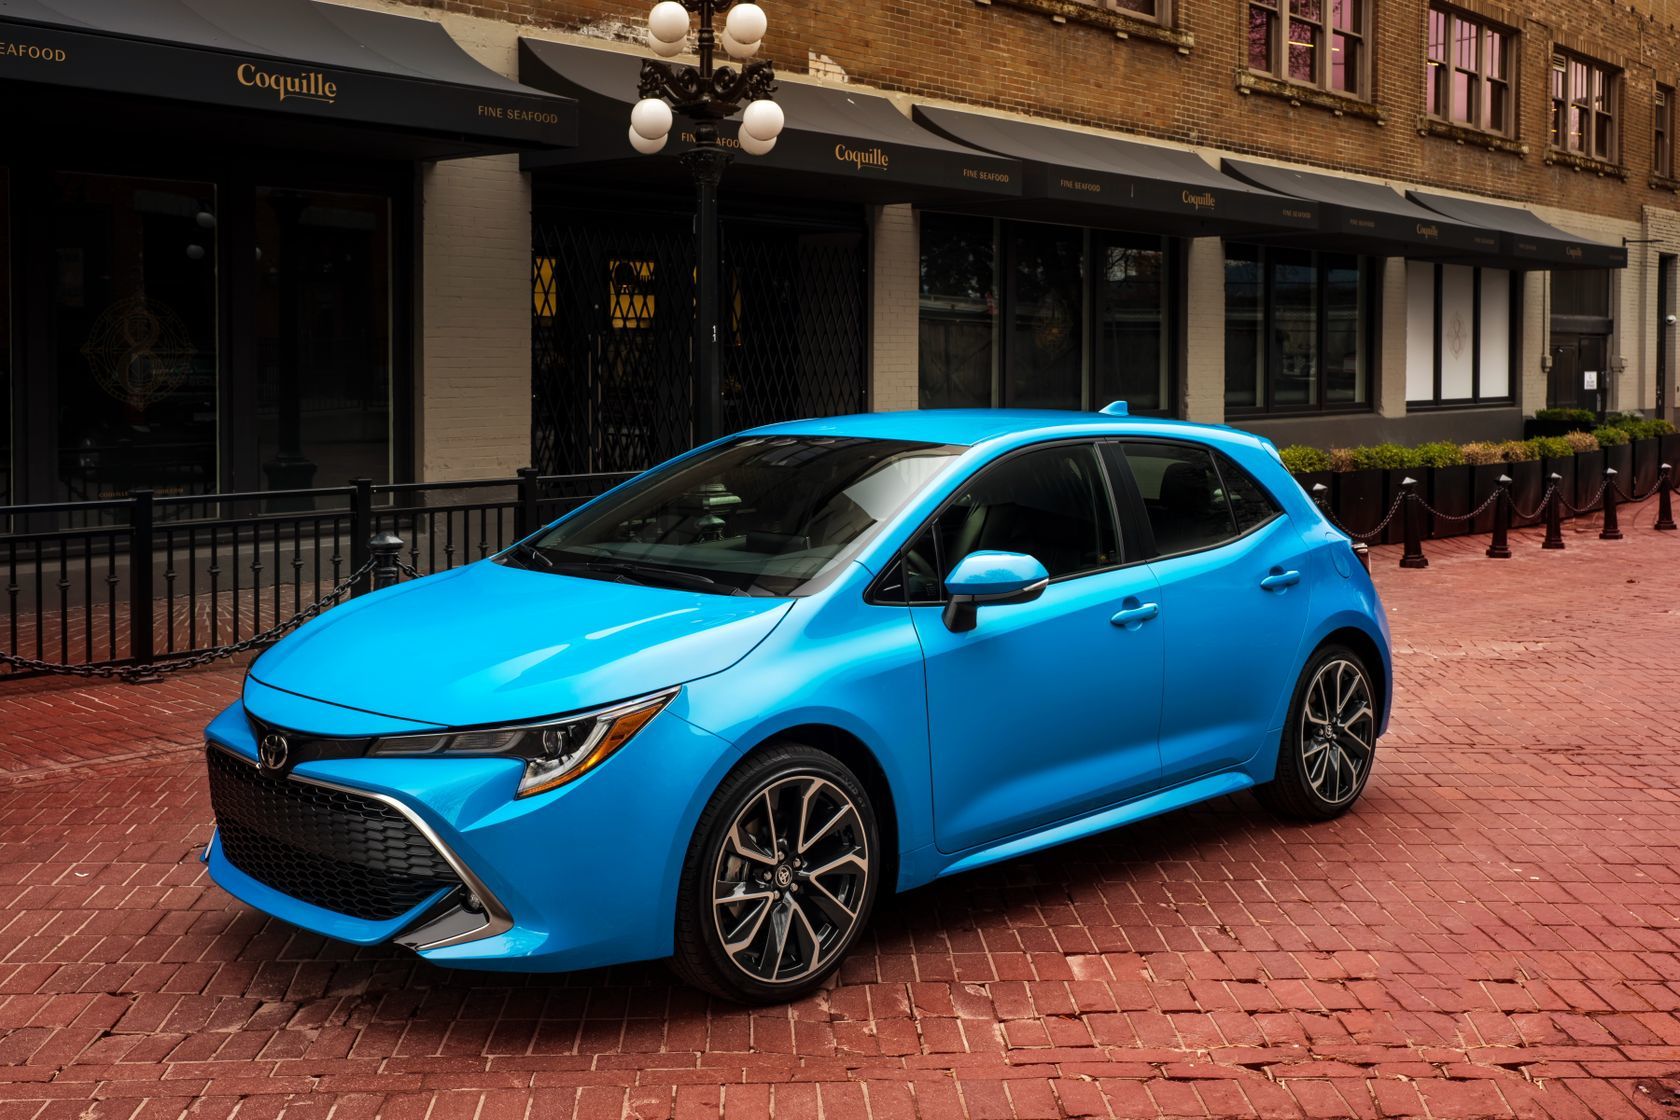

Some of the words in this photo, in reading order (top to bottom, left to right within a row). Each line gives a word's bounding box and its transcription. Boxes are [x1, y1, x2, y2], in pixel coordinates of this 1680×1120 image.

[236, 63, 337, 104] Coquille
[477, 104, 503, 119] FINE
[506, 108, 559, 125] SEAFOOD
[681, 131, 697, 144] FIN
[714, 136, 742, 149] AFOO
[835, 143, 889, 171] Coquille
[963, 168, 978, 179] FINE
[979, 170, 1009, 184] SEAFOOD
[1060, 178, 1073, 190] FINE
[1182, 190, 1216, 210] Coquille
